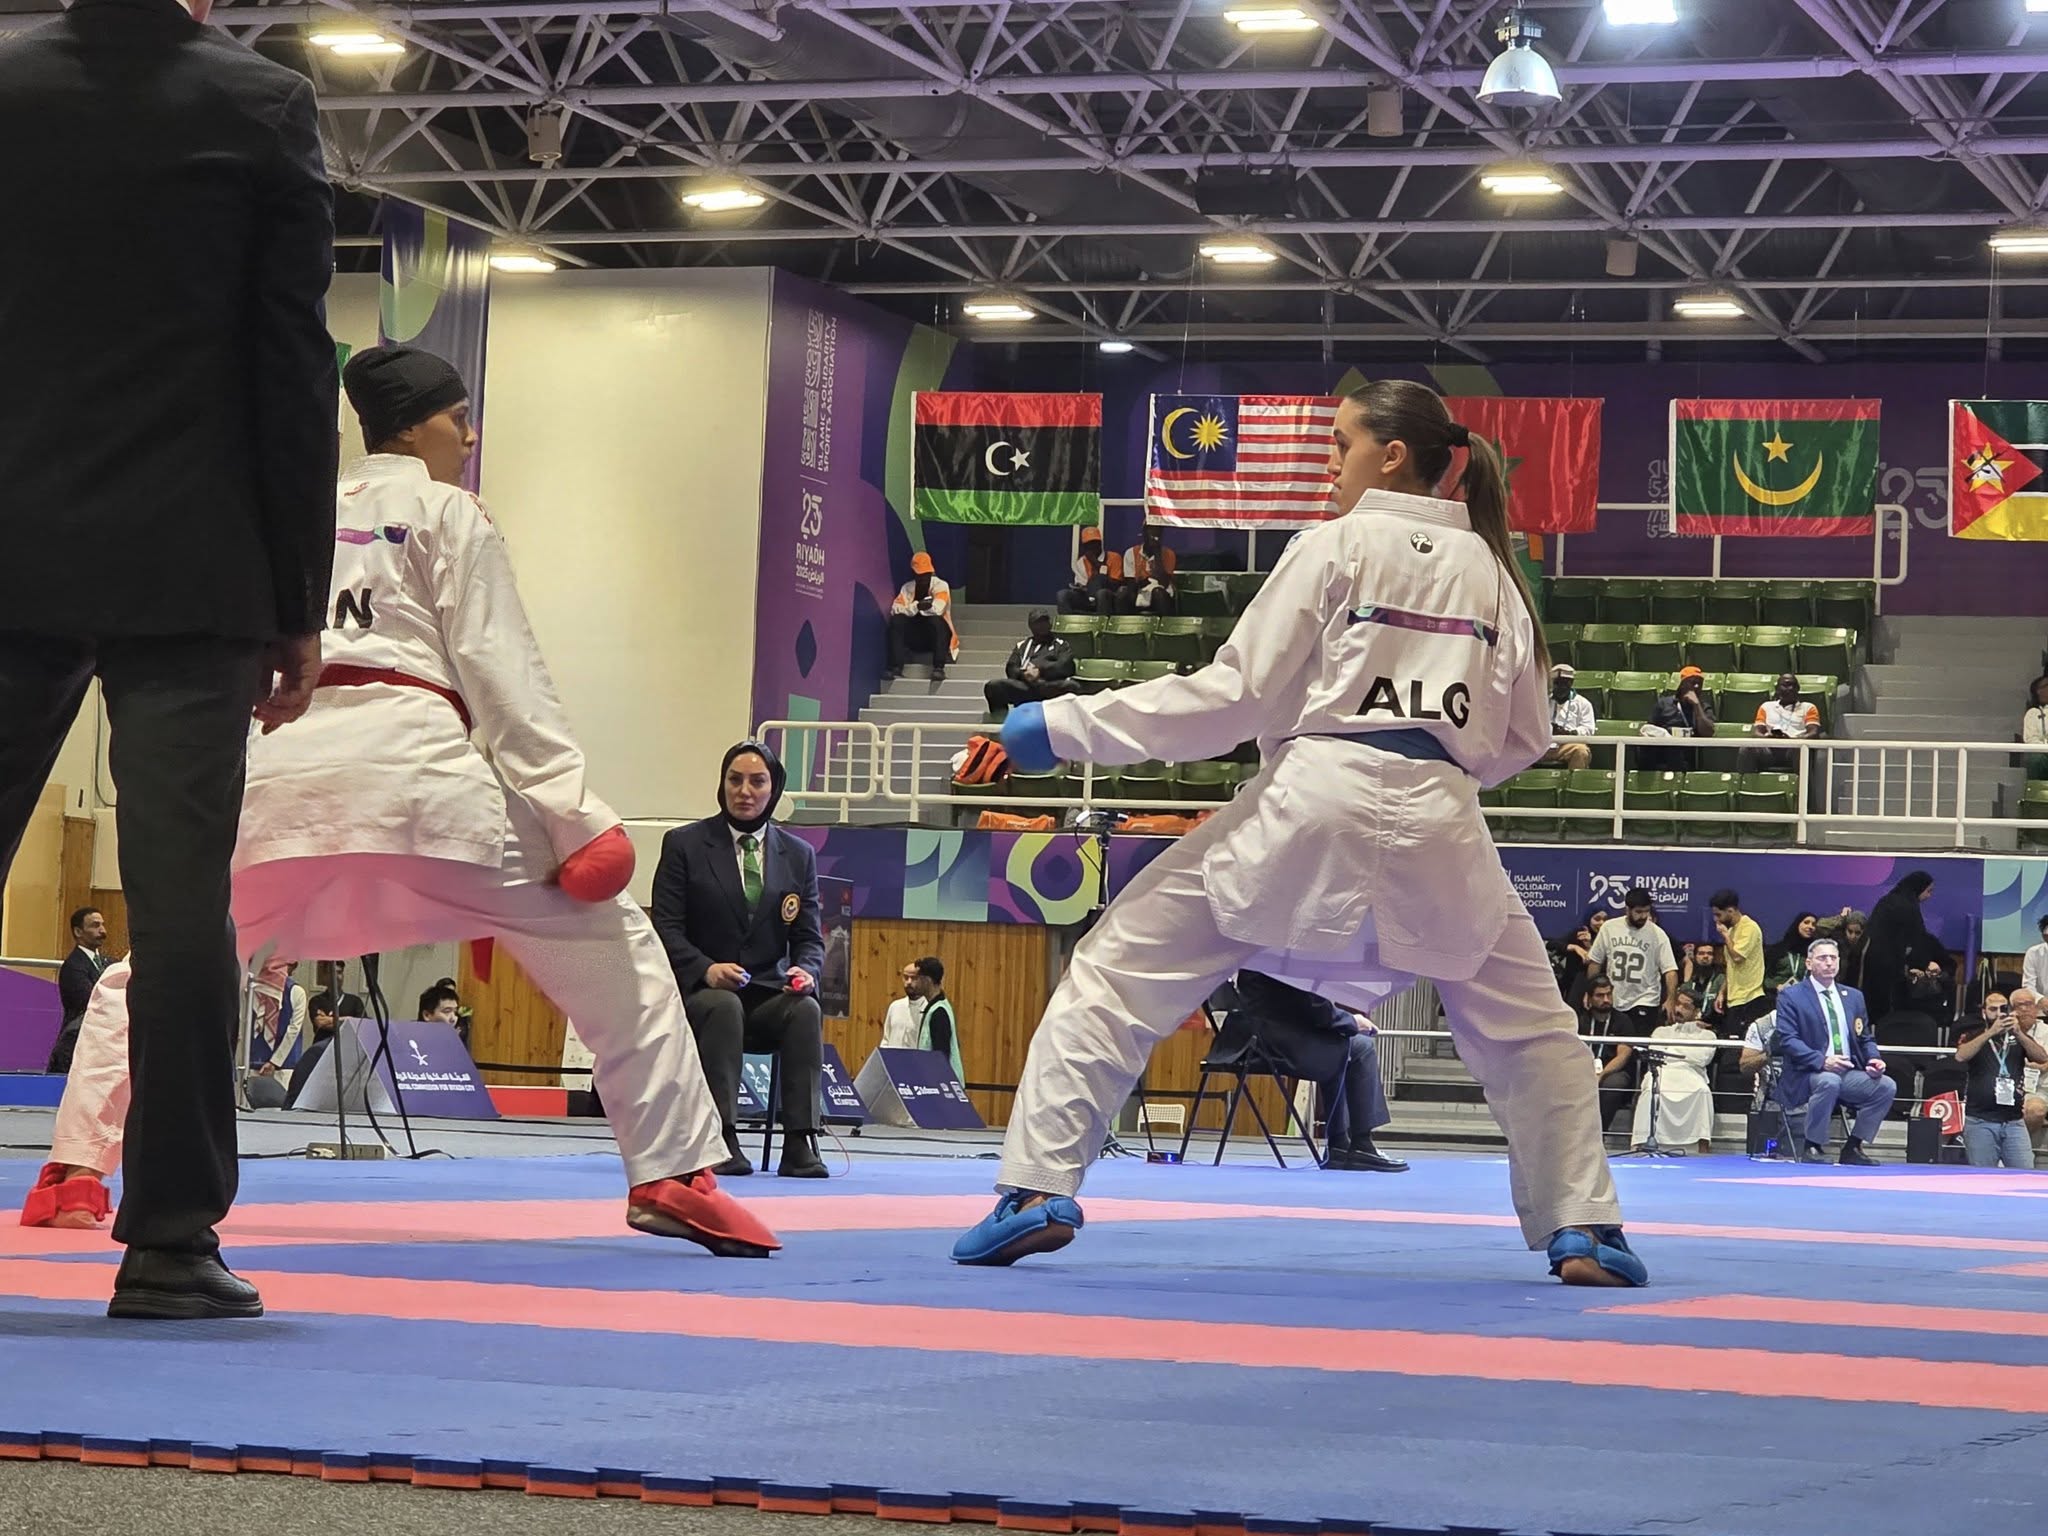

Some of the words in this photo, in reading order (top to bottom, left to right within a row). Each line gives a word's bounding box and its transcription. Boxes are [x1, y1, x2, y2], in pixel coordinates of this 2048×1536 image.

[820, 319, 831, 409] SOLIDARITY
[826, 315, 838, 415] ASSOCIATION
[817, 413, 827, 472] ISLAMIC
[823, 417, 832, 472] SPORTS
[796, 542, 825, 567] RIYADH
[1355, 675, 1471, 729] ALG
[1514, 874, 1546, 883] ISLAMIC
[1514, 883, 1562, 891] SOLIDARITY
[1635, 873, 1689, 891] RIYADH
[1518, 891, 1544, 899] PORTS
[1523, 899, 1567, 908] SOCIATION
[1611, 936, 1650, 952] DALLAS
[1611, 951, 1645, 984] 32
